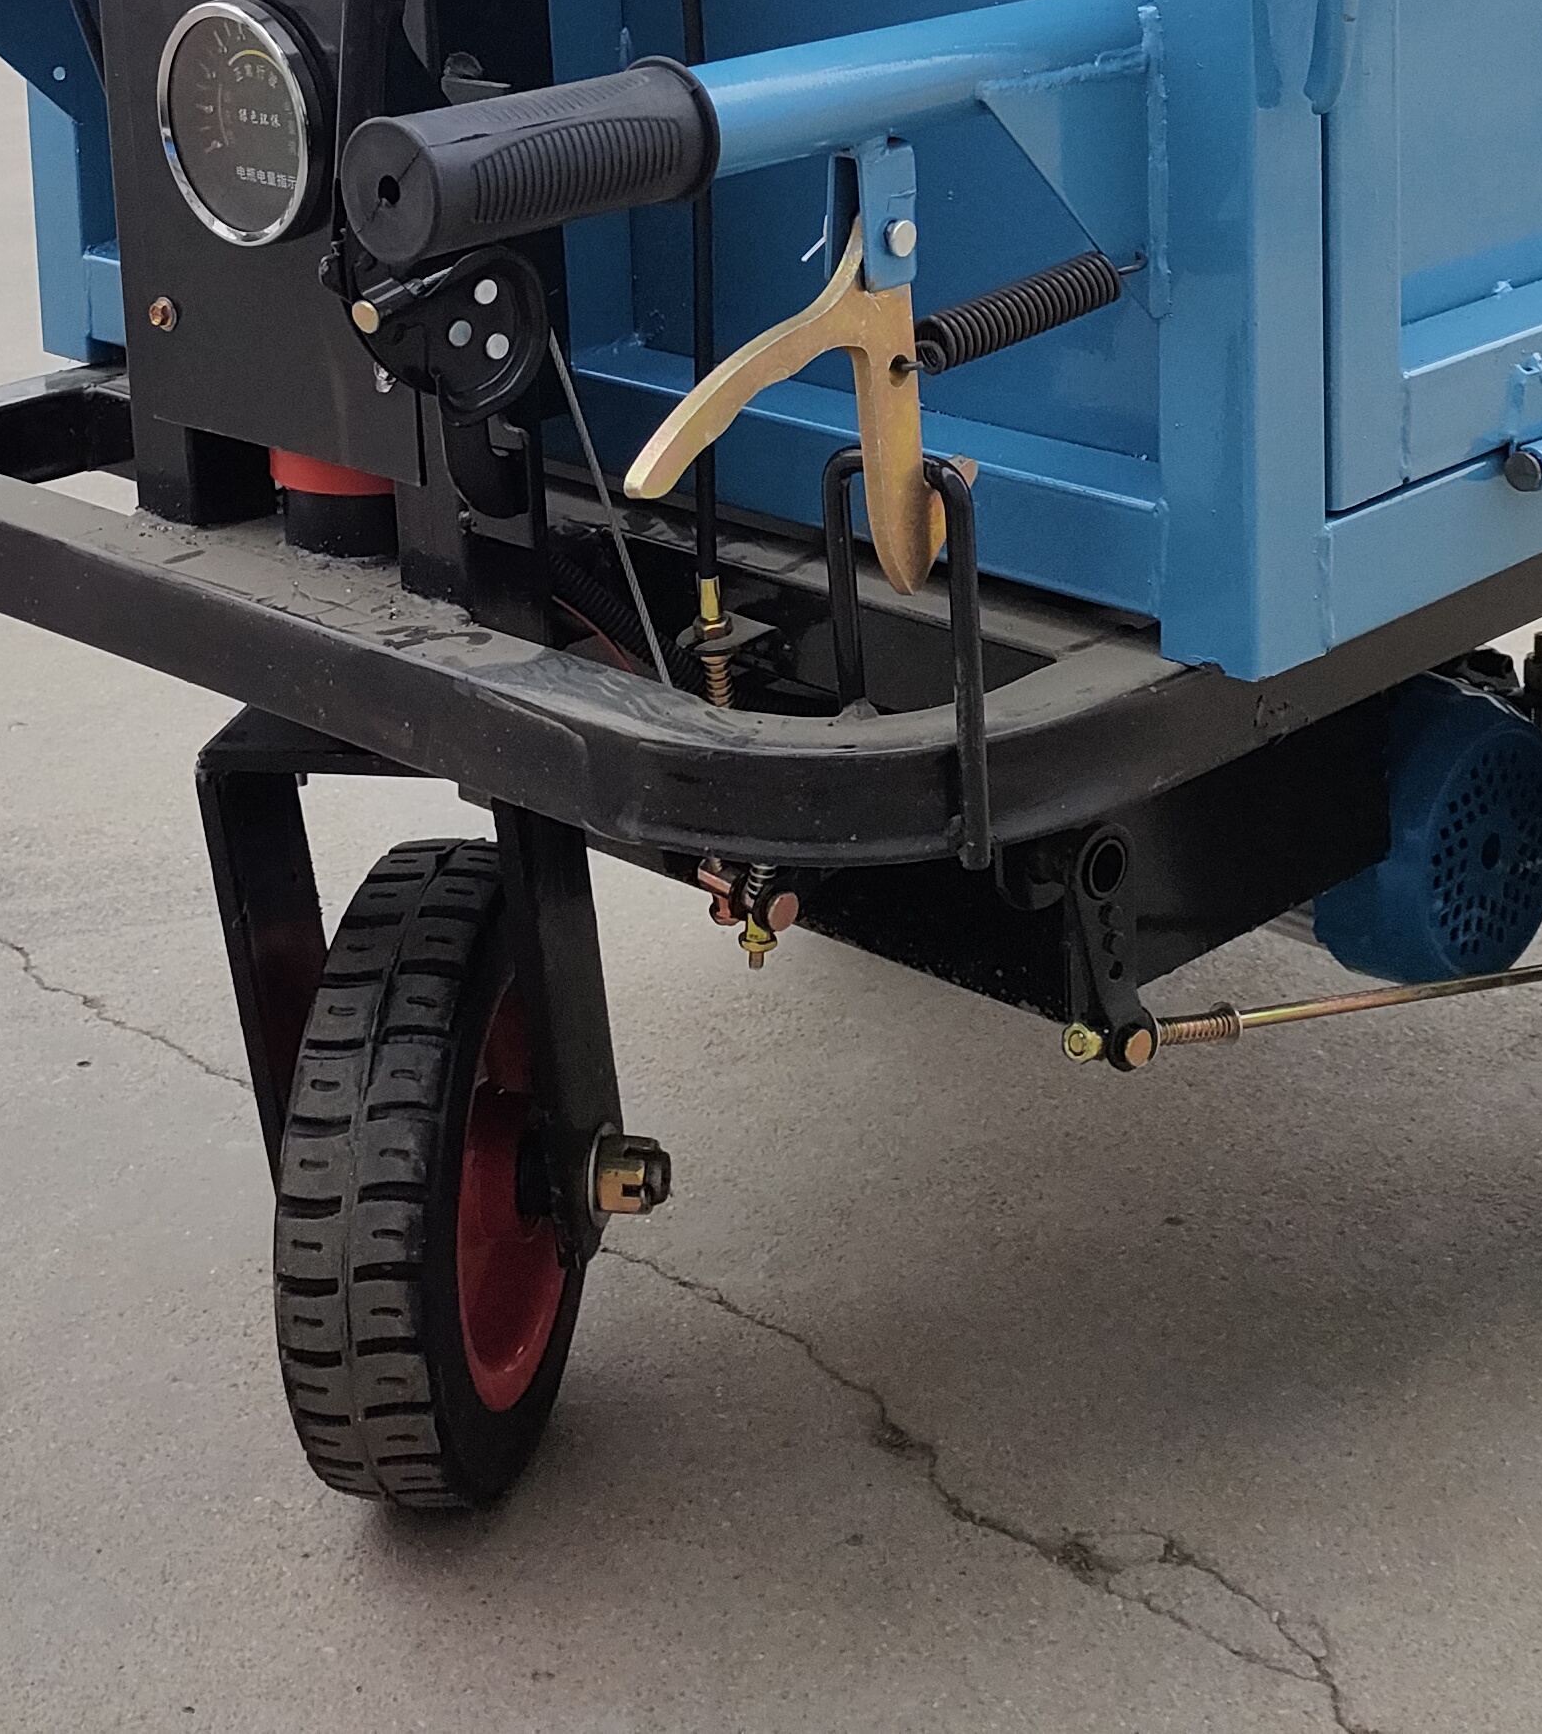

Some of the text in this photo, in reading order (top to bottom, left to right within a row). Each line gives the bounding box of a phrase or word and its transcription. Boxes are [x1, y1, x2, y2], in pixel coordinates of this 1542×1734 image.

[235, 165, 298, 191] 电瓶电量指示
